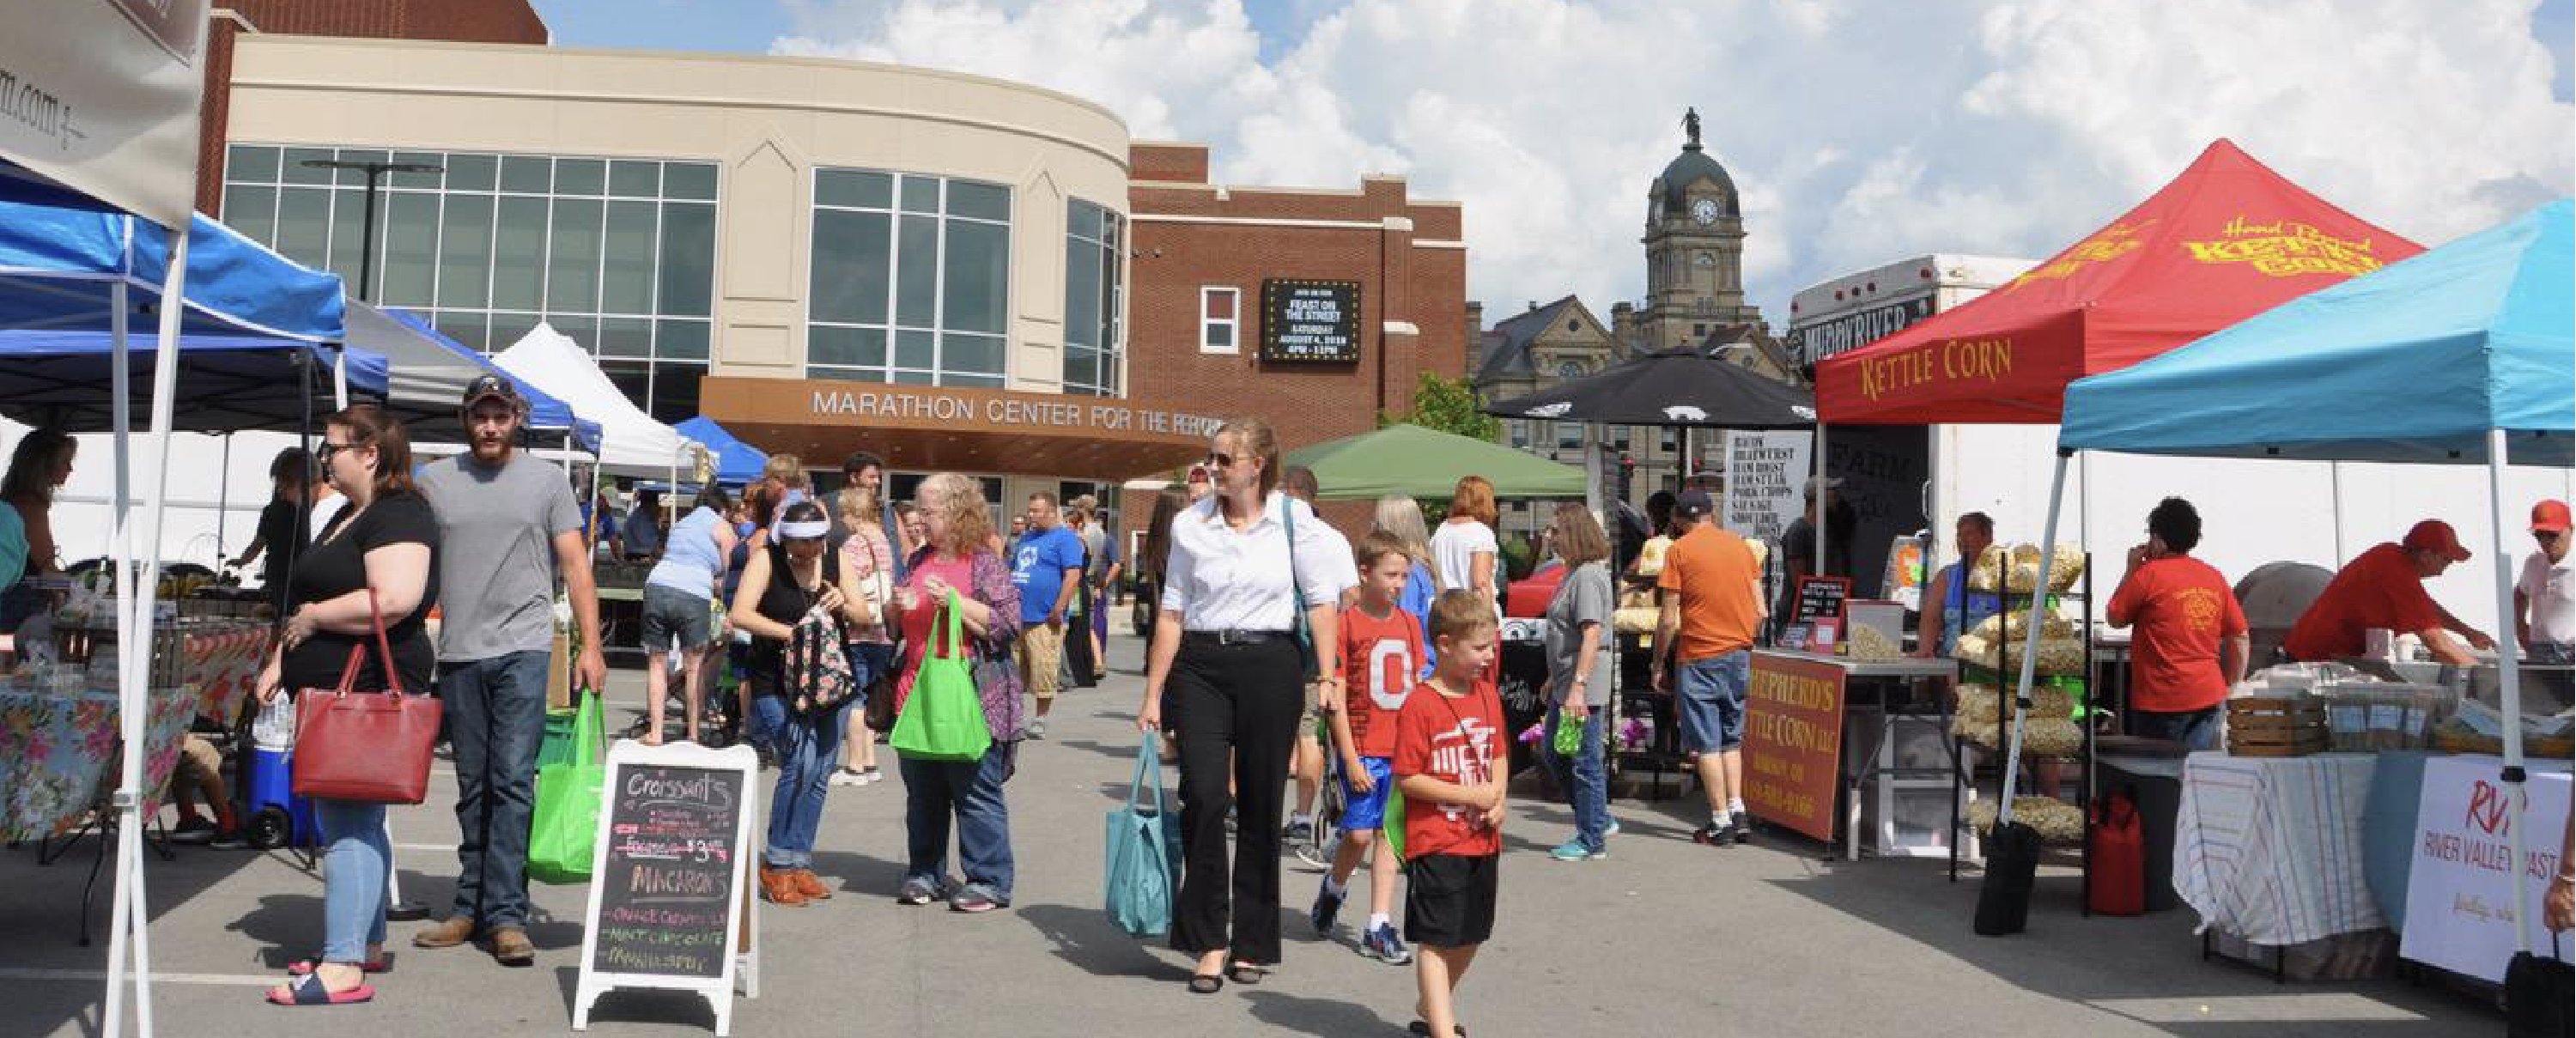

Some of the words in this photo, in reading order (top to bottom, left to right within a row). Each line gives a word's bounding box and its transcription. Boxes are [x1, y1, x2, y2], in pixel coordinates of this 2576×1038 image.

[1285, 308, 1303, 320] THE
[1306, 311, 1341, 322] STREET
[1290, 299, 1319, 309] FEAST
[1321, 300, 1335, 310] ON
[1861, 349, 1933, 402] KETTLE
[1945, 337, 2012, 383] CORN
[812, 392, 974, 420] MARATHON
[987, 398, 1080, 428] CENTER
[1091, 405, 1131, 430] FOR
[1138, 410, 1170, 433] THE
[1733, 487, 1759, 497] PORK
[1761, 486, 1792, 496] CHOPS
[1751, 670, 1835, 712] HEPHERD'S
[1777, 713, 1819, 750] CORN
[2424, 829, 2461, 862] RIVER
[2524, 850, 2558, 880] AST
